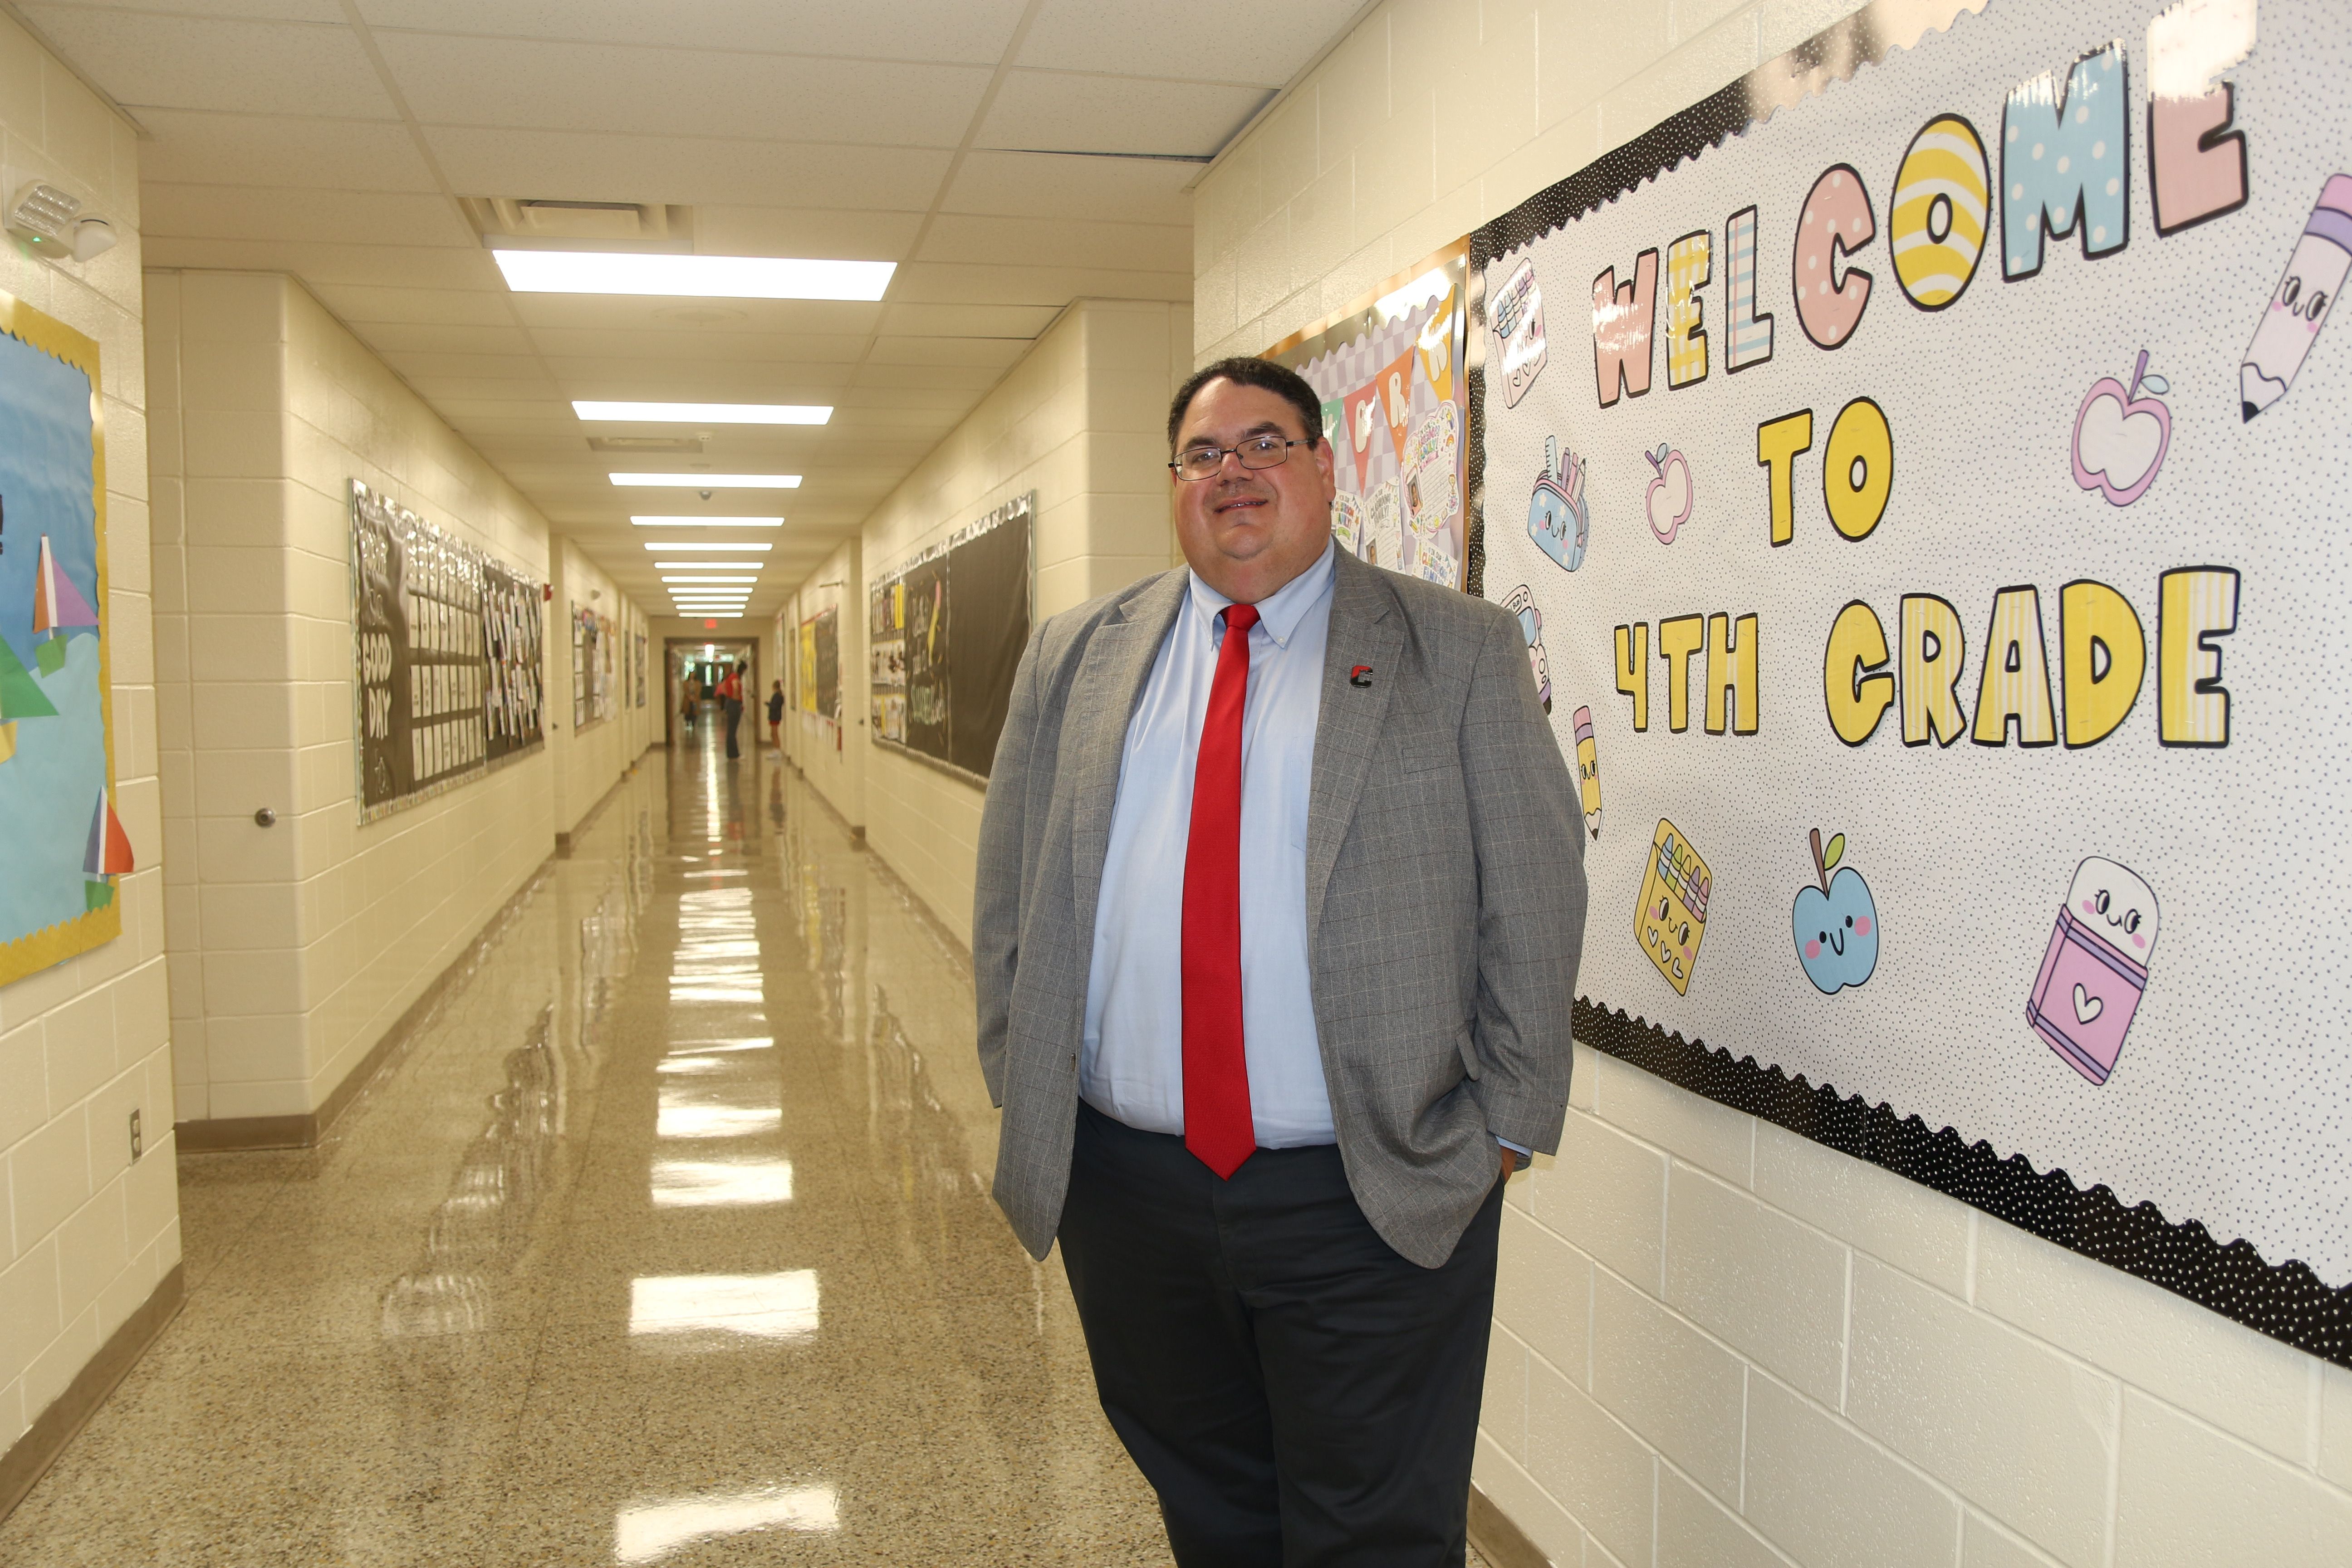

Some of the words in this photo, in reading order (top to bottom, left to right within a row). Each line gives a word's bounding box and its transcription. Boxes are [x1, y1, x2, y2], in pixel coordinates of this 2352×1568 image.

[1592, 0, 2259, 408] WELCOME
[1757, 396, 1894, 547] TO
[363, 632, 392, 685] GOOD
[368, 687, 392, 741] DAY
[1615, 611, 1759, 736] 4TH
[1823, 565, 2240, 750] GRADE
